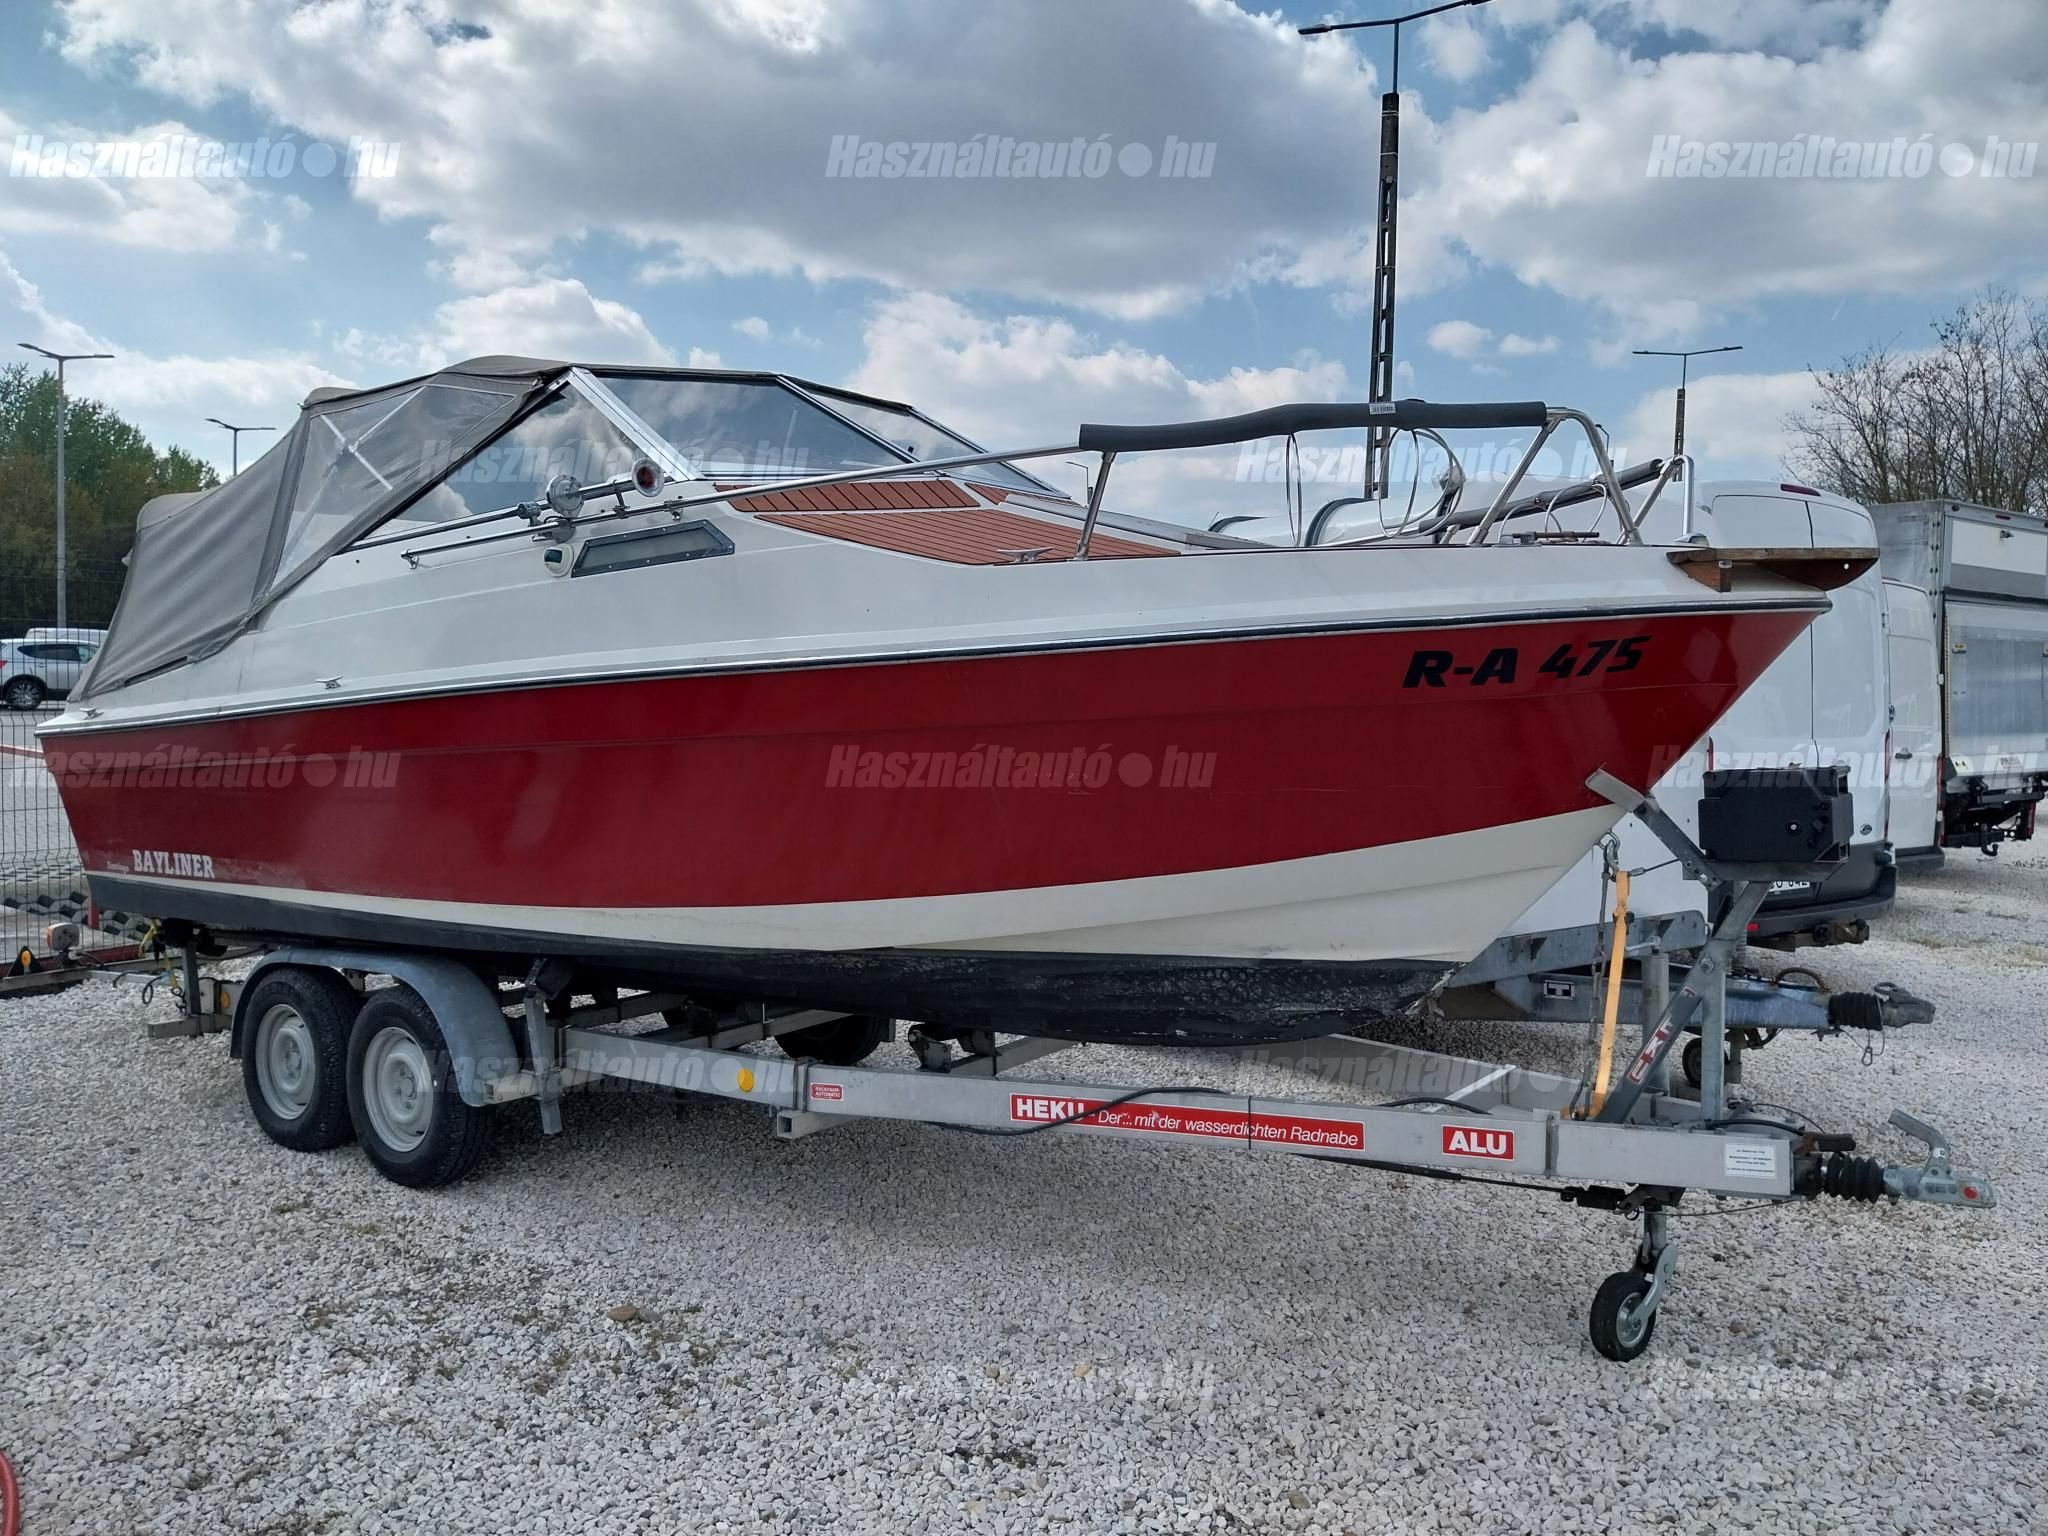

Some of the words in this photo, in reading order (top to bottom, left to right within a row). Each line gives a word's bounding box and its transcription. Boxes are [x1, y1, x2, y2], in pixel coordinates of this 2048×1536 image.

[1402, 648, 1518, 688] R-A
[1538, 635, 1651, 679] 475
[132, 849, 216, 879] BAYLINER
[1135, 1114, 1156, 1127] mit
[1158, 1115, 1181, 1129] der
[1185, 1119, 1286, 1139] wasserdichten
[1290, 1126, 1358, 1146] Radnabe
[1448, 1130, 1507, 1154] ALU
